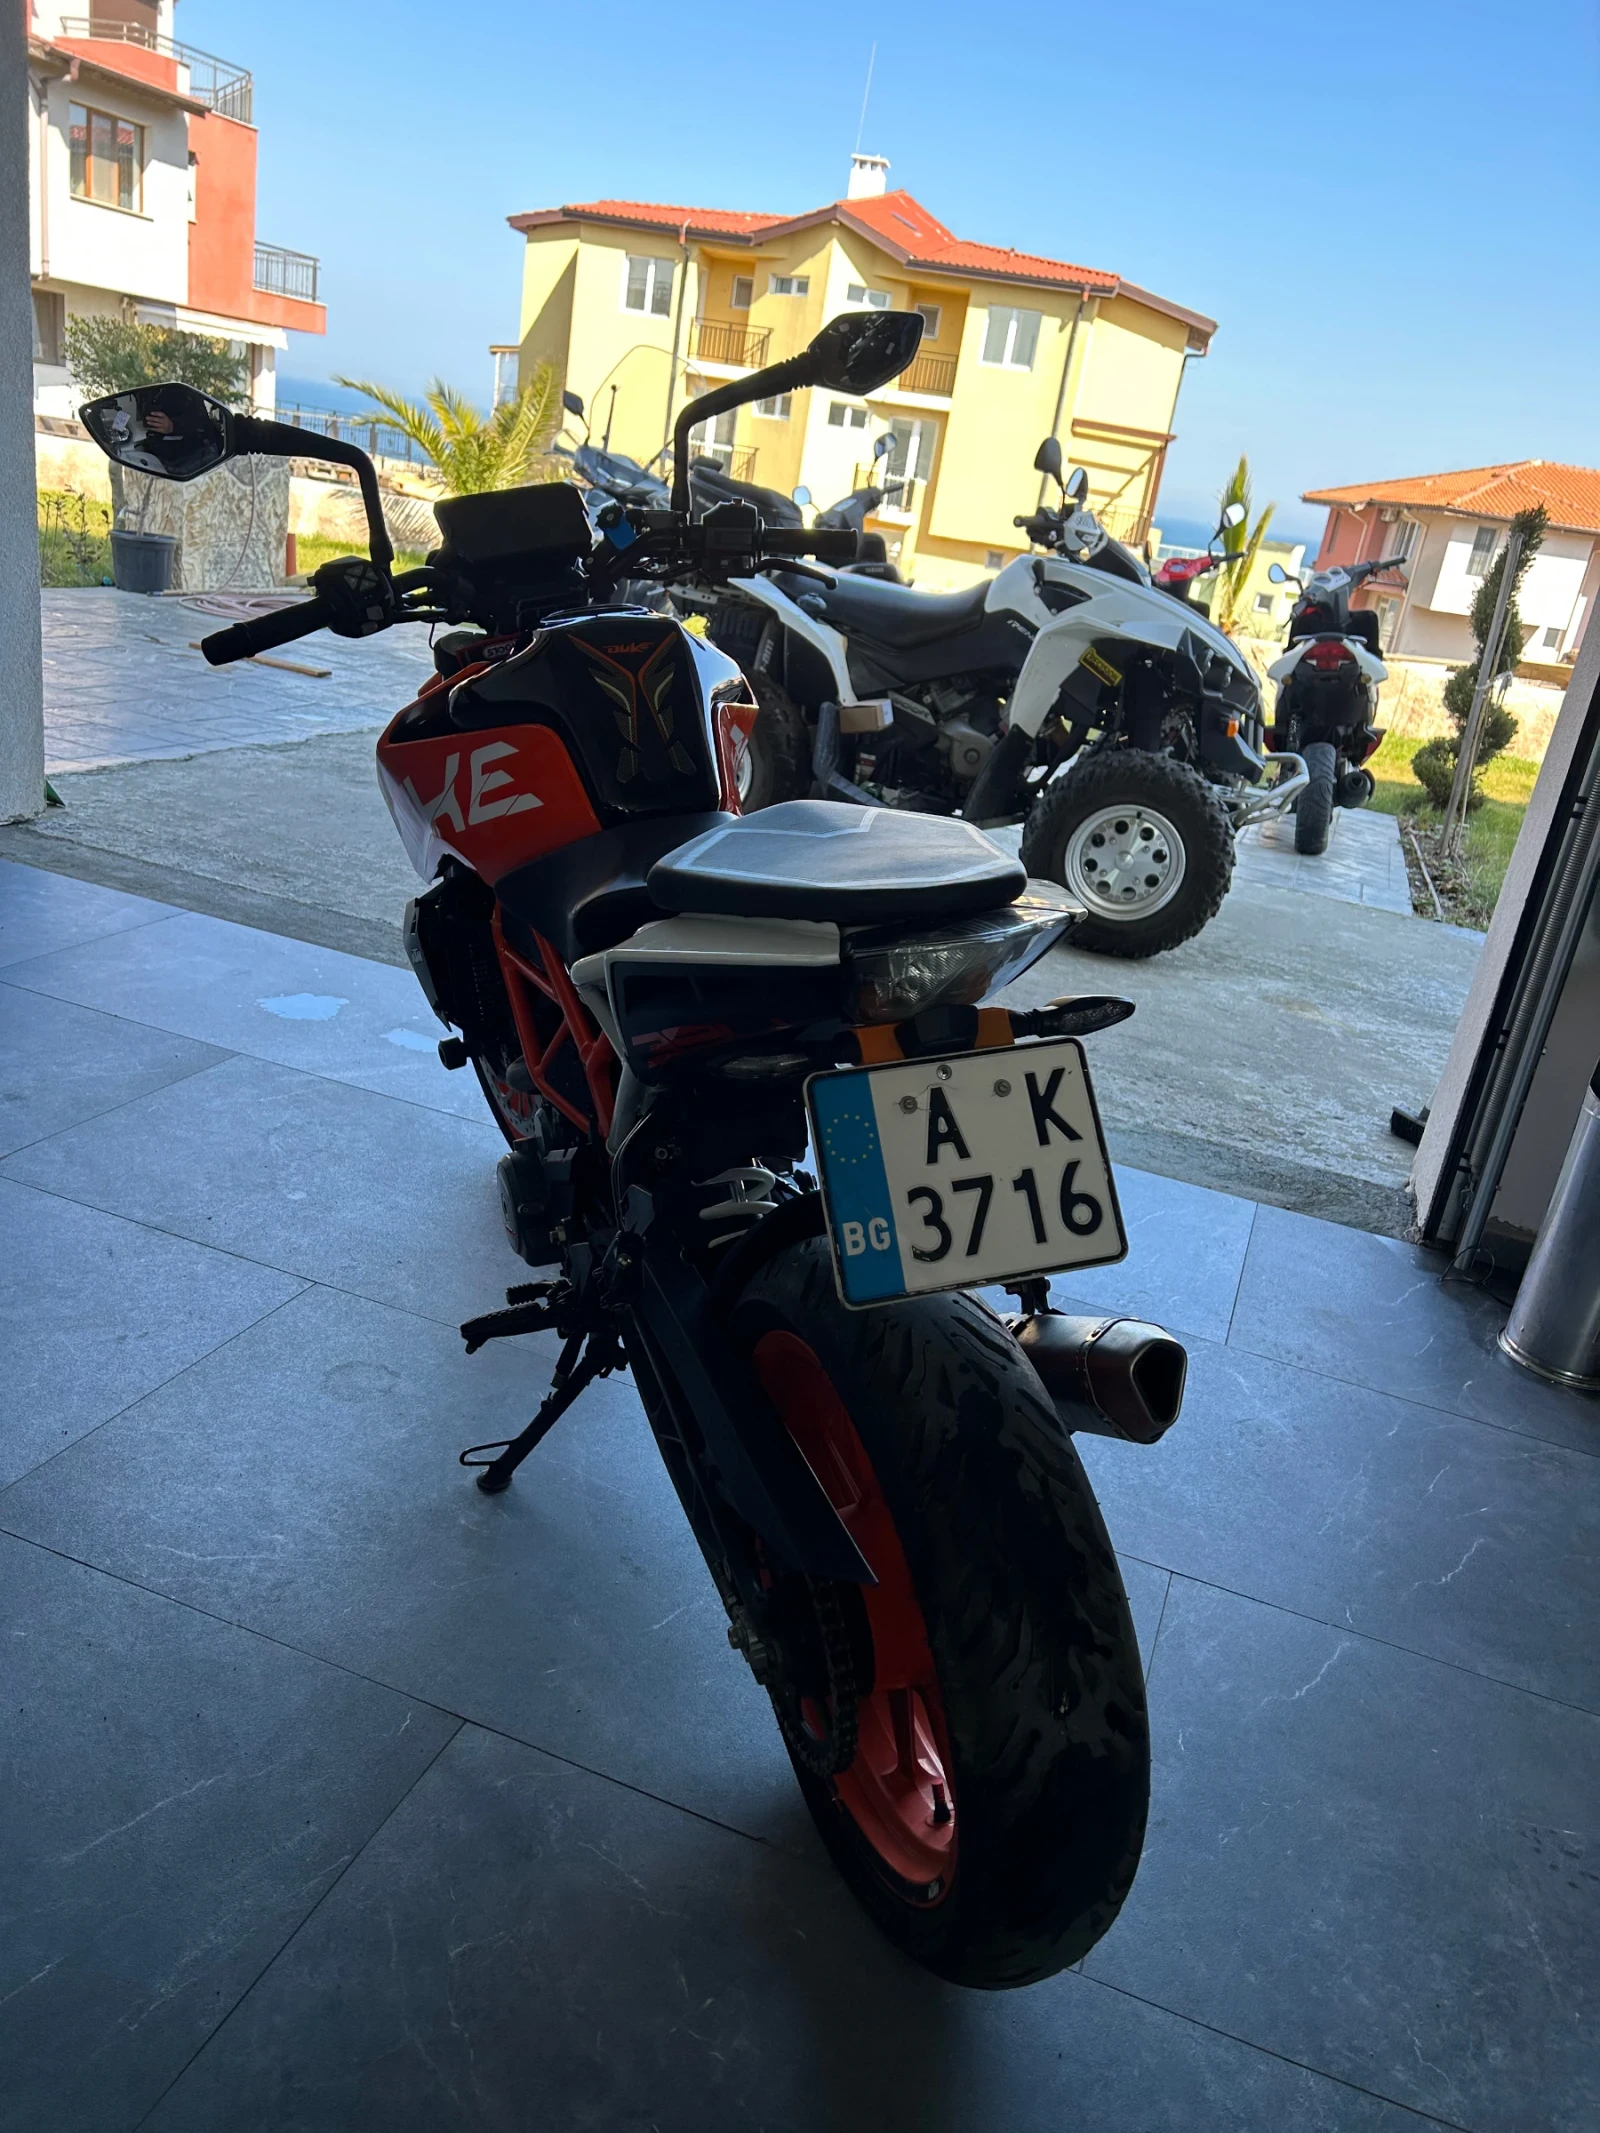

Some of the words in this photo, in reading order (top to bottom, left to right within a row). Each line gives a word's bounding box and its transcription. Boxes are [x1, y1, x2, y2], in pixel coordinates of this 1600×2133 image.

[925, 1085, 972, 1165] A
[1024, 1066, 1084, 1147] K
[841, 1216, 892, 1257] BG
[906, 1159, 1104, 1263] 3716
